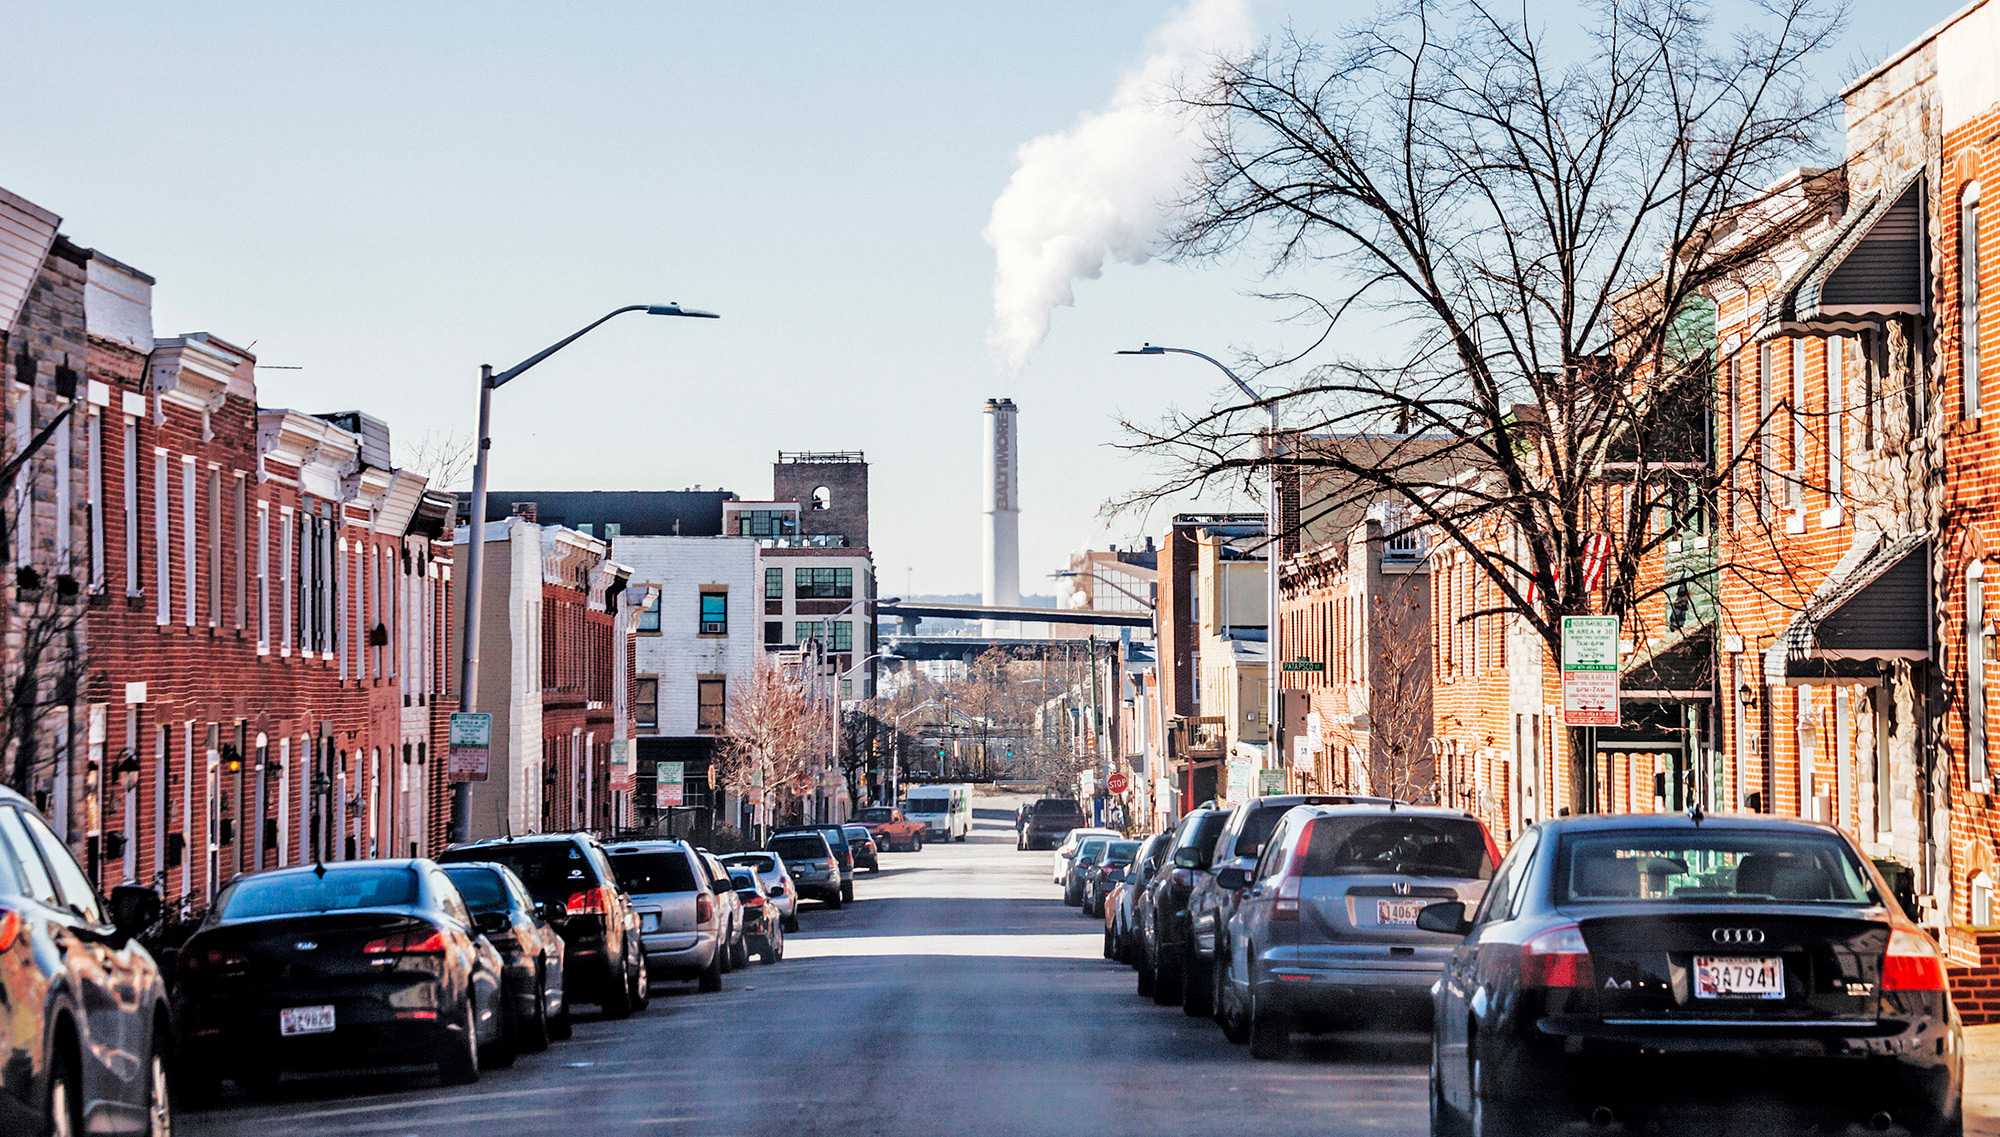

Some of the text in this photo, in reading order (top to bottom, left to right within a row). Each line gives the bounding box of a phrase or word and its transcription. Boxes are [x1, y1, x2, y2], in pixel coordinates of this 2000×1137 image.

[996, 412, 1009, 510] BALTIMORE
[1284, 662, 1313, 670] PATAPSCO
[1109, 778, 1126, 788] STOP
